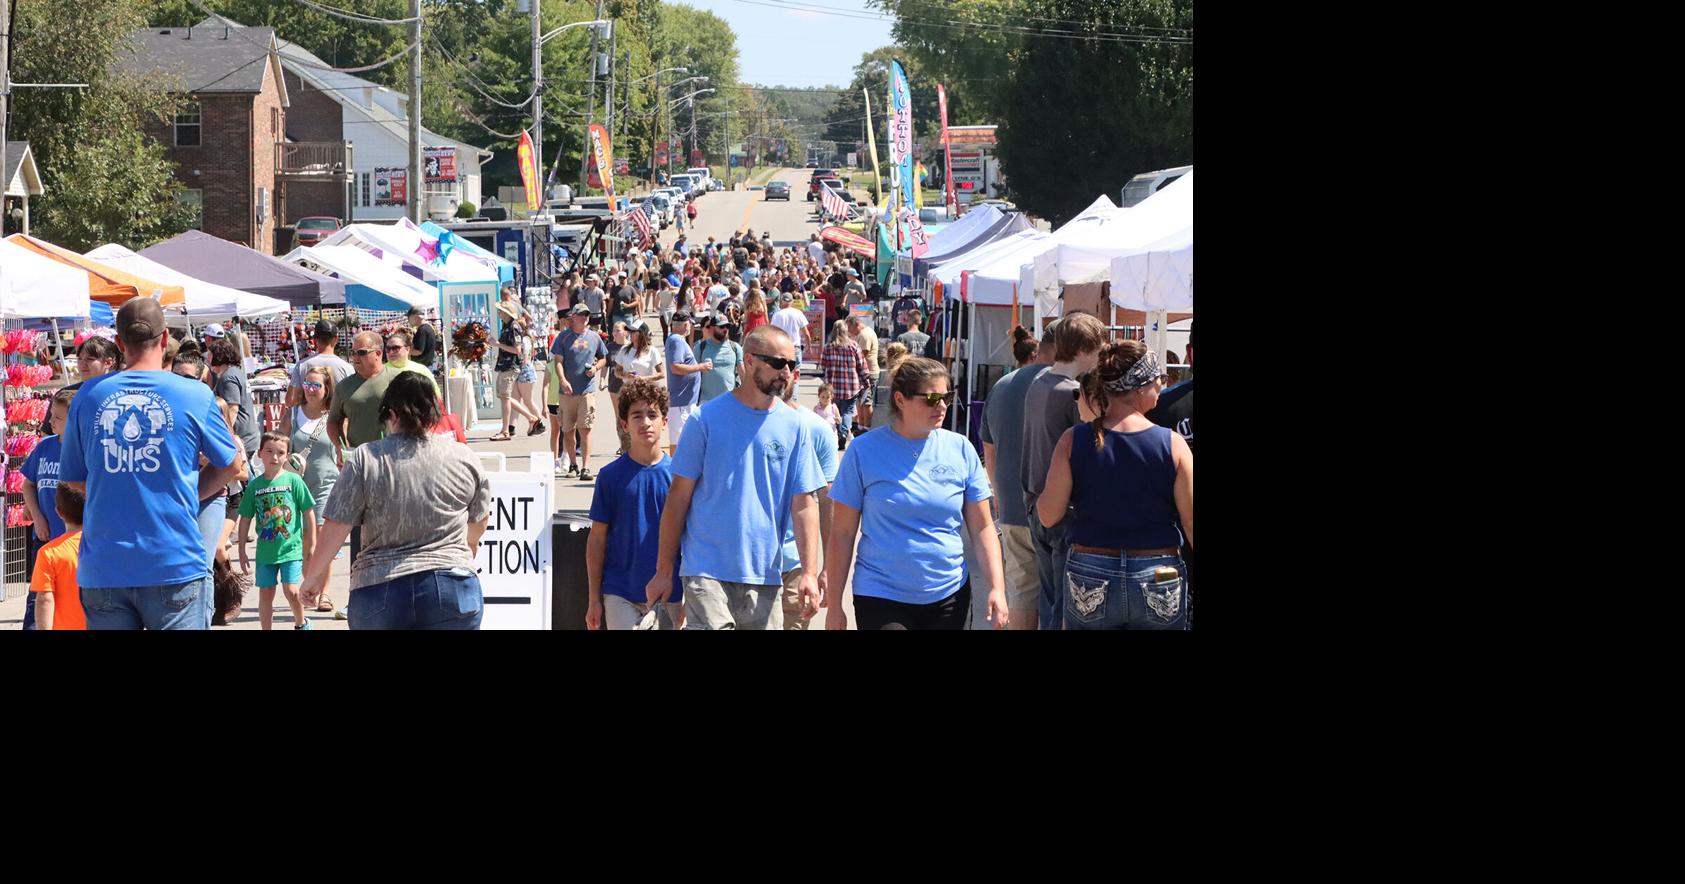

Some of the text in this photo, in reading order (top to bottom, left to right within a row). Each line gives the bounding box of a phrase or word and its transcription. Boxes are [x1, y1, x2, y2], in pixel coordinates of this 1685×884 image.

[94, 407, 103, 435] UTILITY
[160, 399, 174, 432] SERVICES
[104, 445, 161, 474] U.I.S
[476, 539, 540, 575] TION
